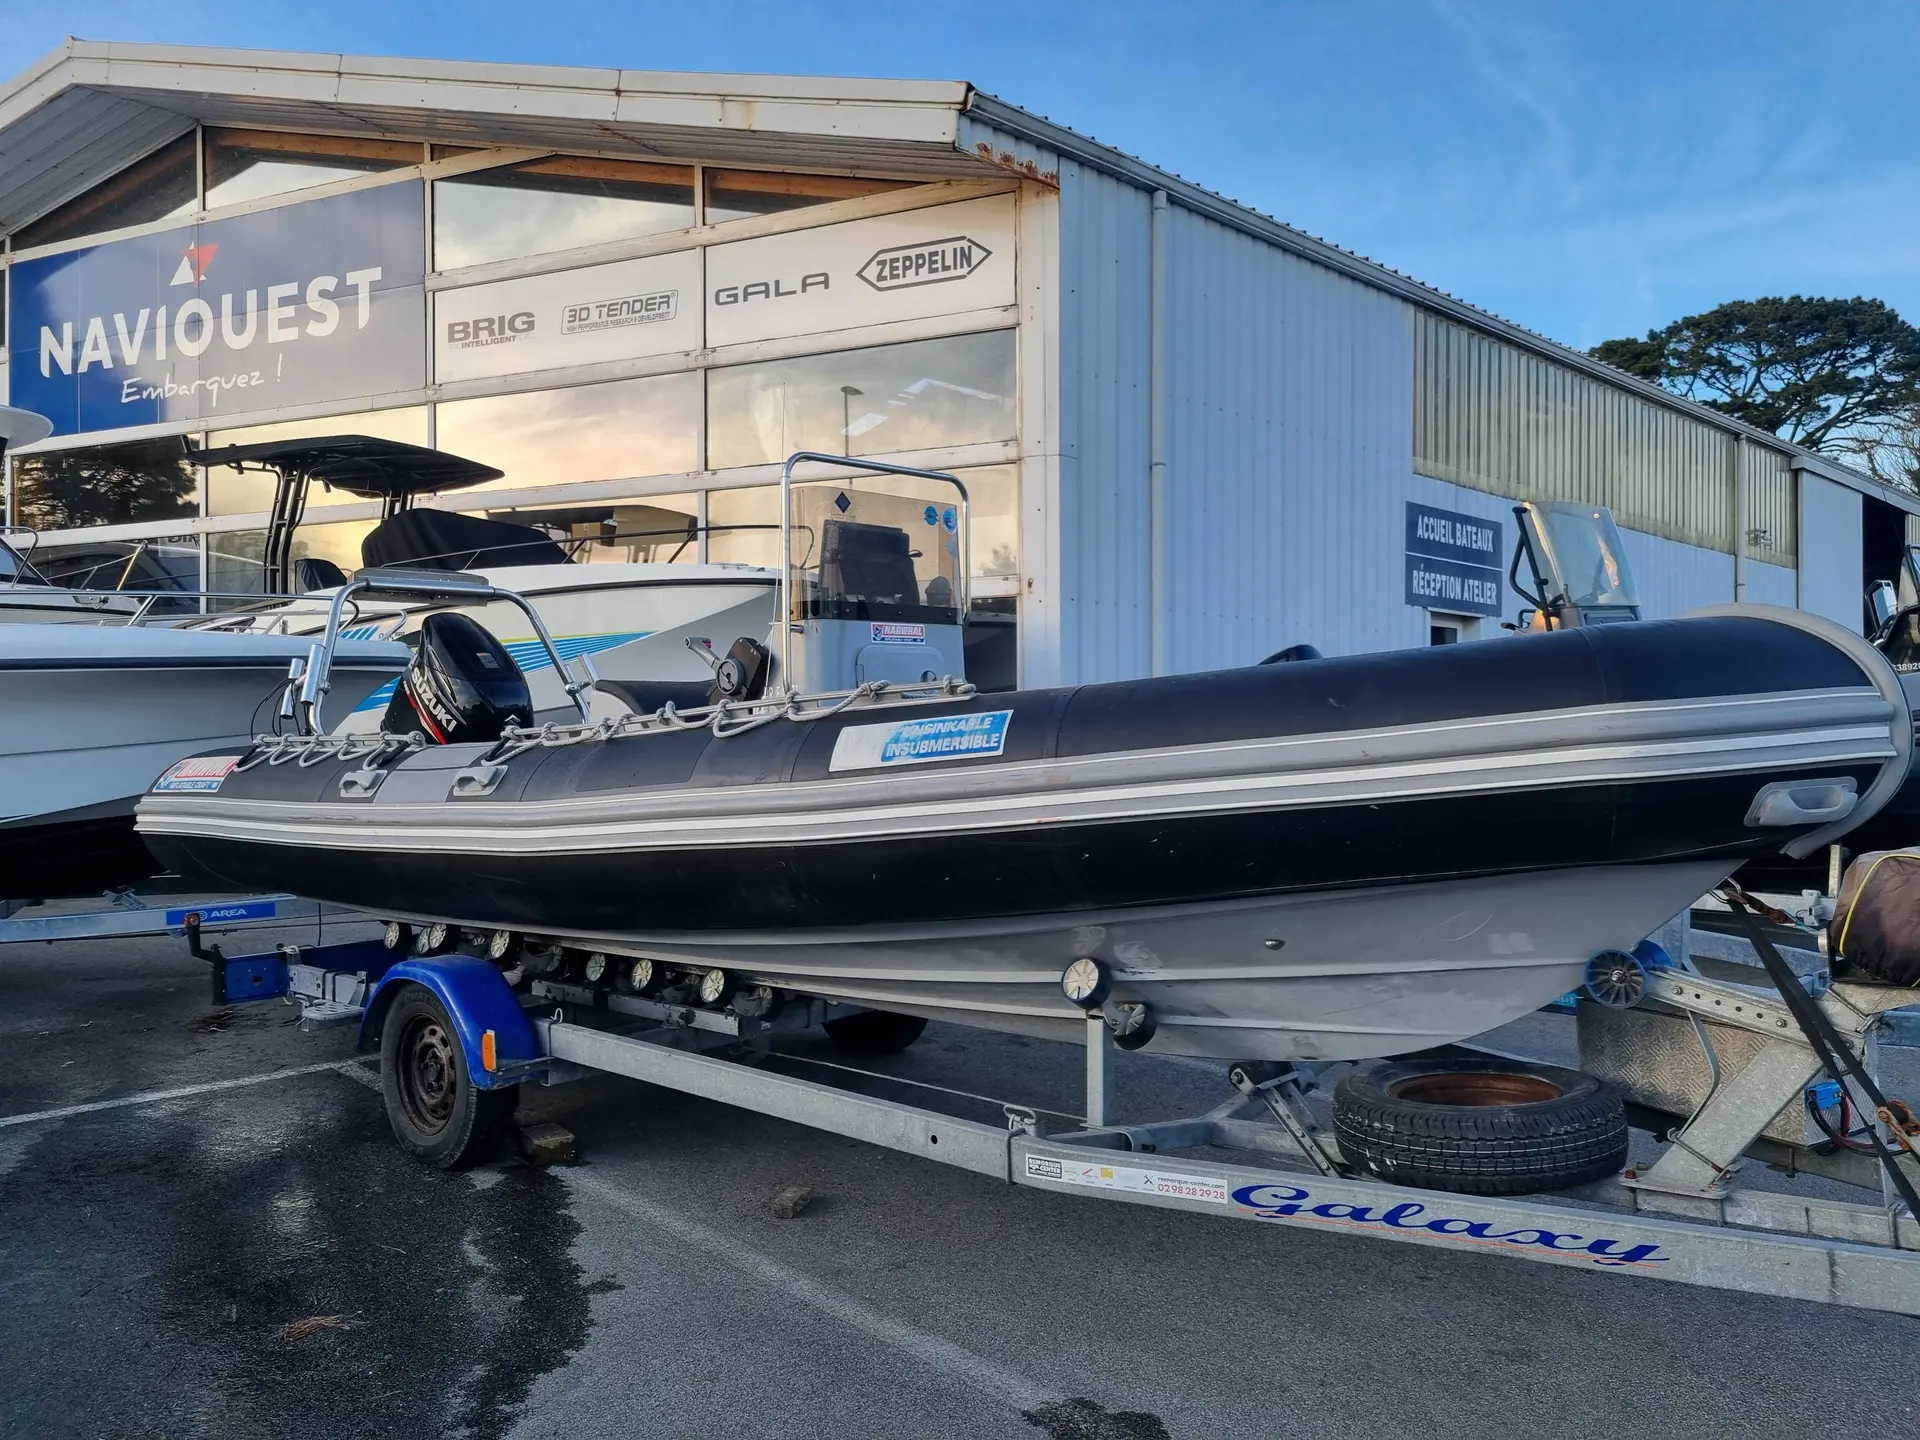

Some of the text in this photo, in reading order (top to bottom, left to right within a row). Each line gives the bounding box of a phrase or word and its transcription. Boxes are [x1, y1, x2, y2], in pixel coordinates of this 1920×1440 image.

[876, 245, 972, 283] ZEPPELIN
[714, 272, 830, 306] GALA
[39, 267, 382, 378] NAVIOUEST
[567, 307, 590, 323] 3D
[578, 320, 609, 330] PERFORMANCE
[610, 317, 633, 327] RESEARCH
[638, 311, 670, 323] DEVELOPMENT
[448, 312, 535, 343] BRIG
[461, 335, 517, 349] INTELLIGENT
[121, 353, 283, 407] Embarquez !
[1417, 514, 1494, 552] ACCUEIL BATEAUX
[1412, 563, 1497, 606] RÉCEPTION ATELIER
[412, 667, 458, 733] SUZUKI
[886, 733, 1000, 757] INSUBMERSIBLE
[194, 781, 210, 789] CRAFT
[210, 909, 248, 918] AREA
[1028, 1158, 1061, 1169] REMORQUE
[1039, 1165, 1061, 1174] CENTER
[1157, 1176, 1225, 1190] remorque-center.com
[1158, 1184, 1225, 1200] 02 98 28 29 28
[1231, 1184, 1670, 1266] Galaxy
